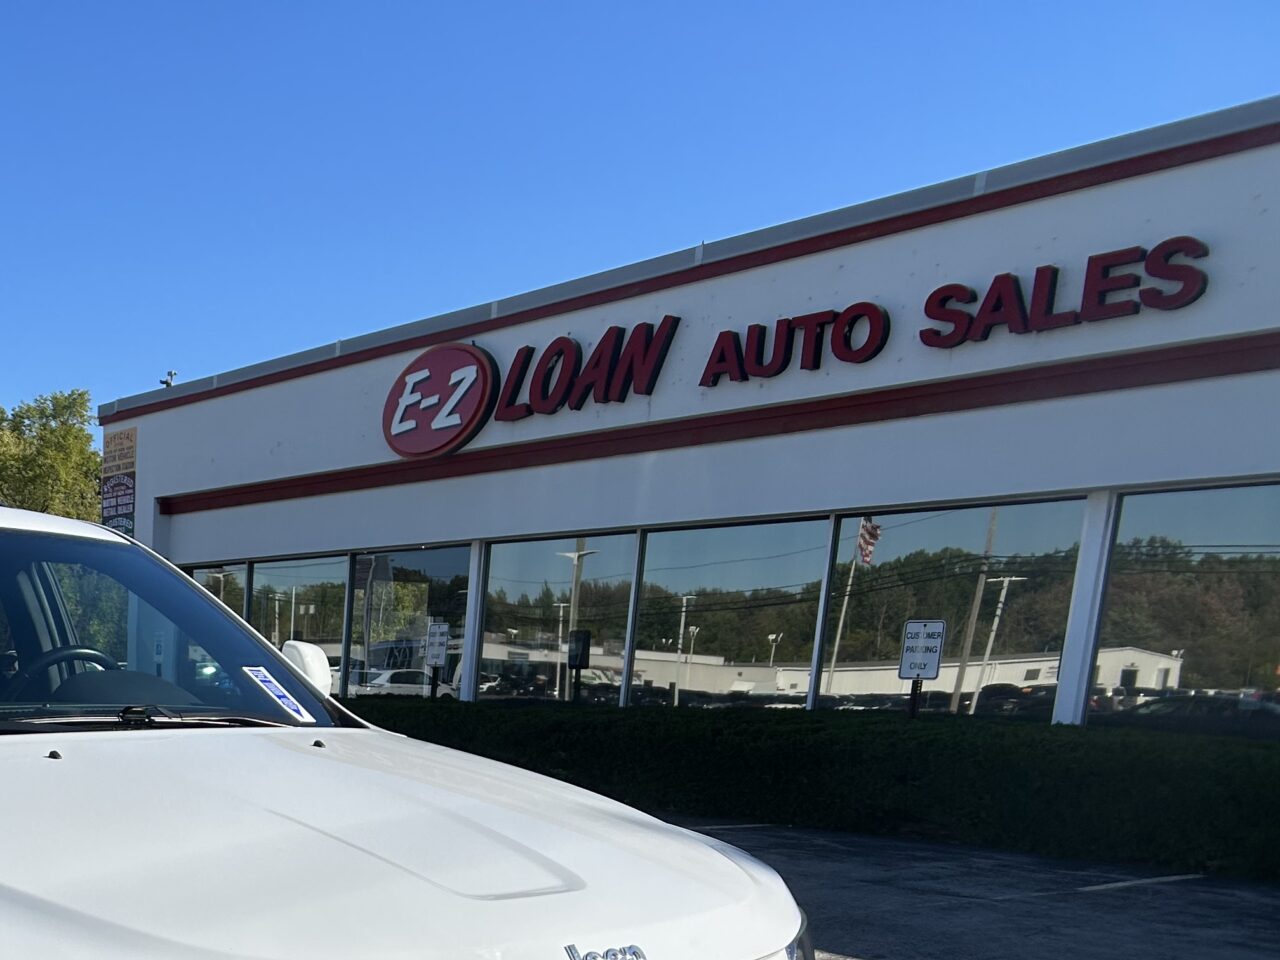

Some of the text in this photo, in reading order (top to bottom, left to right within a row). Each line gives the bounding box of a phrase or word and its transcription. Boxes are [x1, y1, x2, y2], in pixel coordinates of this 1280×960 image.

[391, 235, 1210, 436] E-Z LOAN AUTO SALES
[105, 431, 133, 449] OFFICIAL
[118, 450, 134, 460] VEHICLE
[103, 474, 134, 492] REGISTERED
[907, 632, 942, 640] CUSOMER
[909, 662, 928, 670] ONLY
